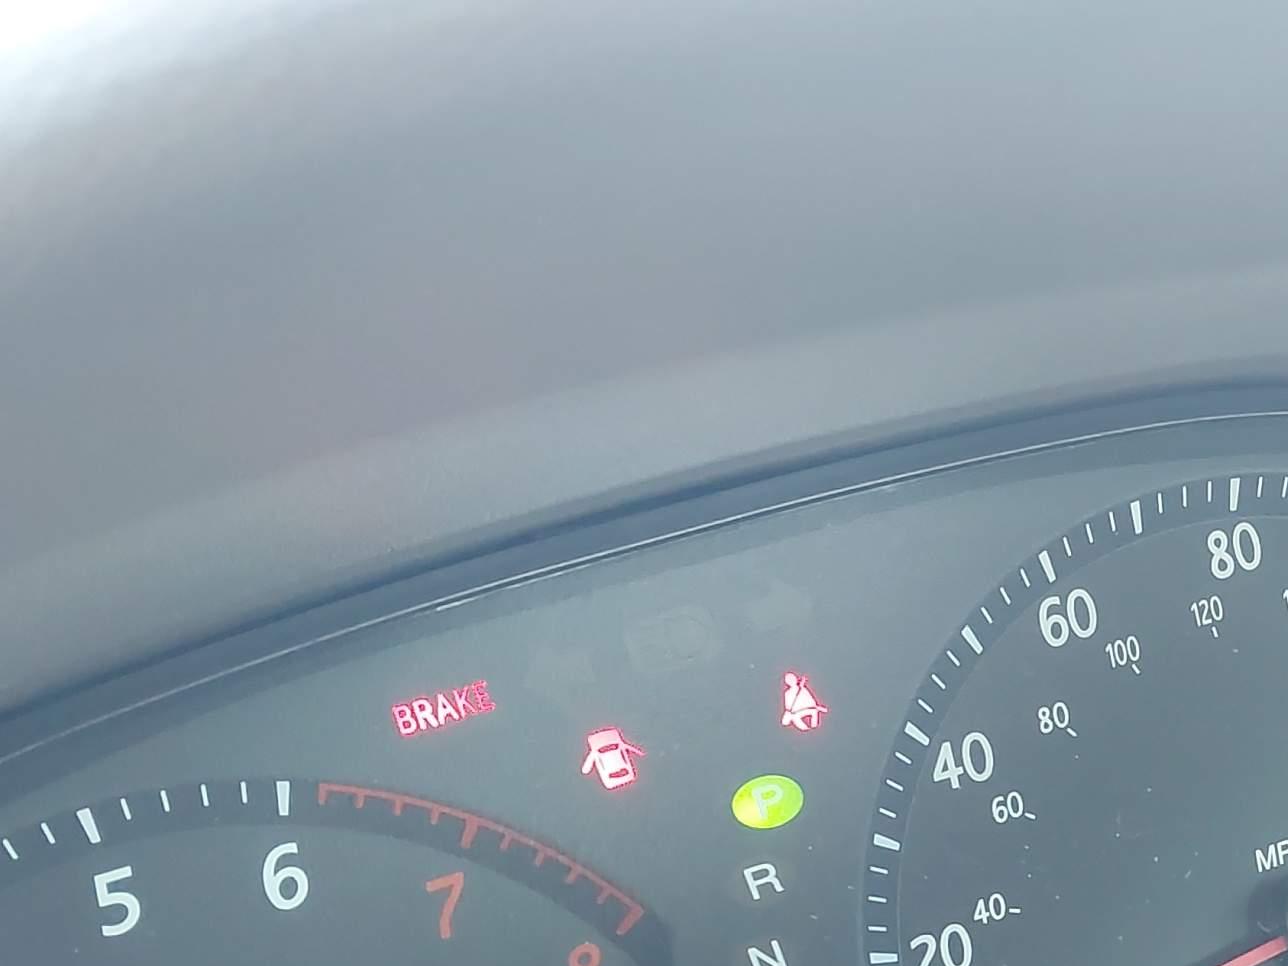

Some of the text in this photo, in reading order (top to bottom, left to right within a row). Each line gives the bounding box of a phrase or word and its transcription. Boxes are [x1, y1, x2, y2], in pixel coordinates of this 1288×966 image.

[1207, 520, 1262, 580] 80
[1037, 588, 1098, 647] 60
[1190, 594, 1225, 628] 120
[1106, 635, 1140, 668] 100
[393, 681, 496, 736] BRAKE
[1037, 701, 1069, 734] 80
[932, 731, 995, 790] 40
[753, 782, 785, 818] P
[991, 791, 1024, 824] 60
[262, 842, 311, 911] 6
[744, 863, 784, 899] R
[93, 866, 142, 937] 5
[425, 871, 465, 940] 7
[973, 893, 1007, 924] 40
